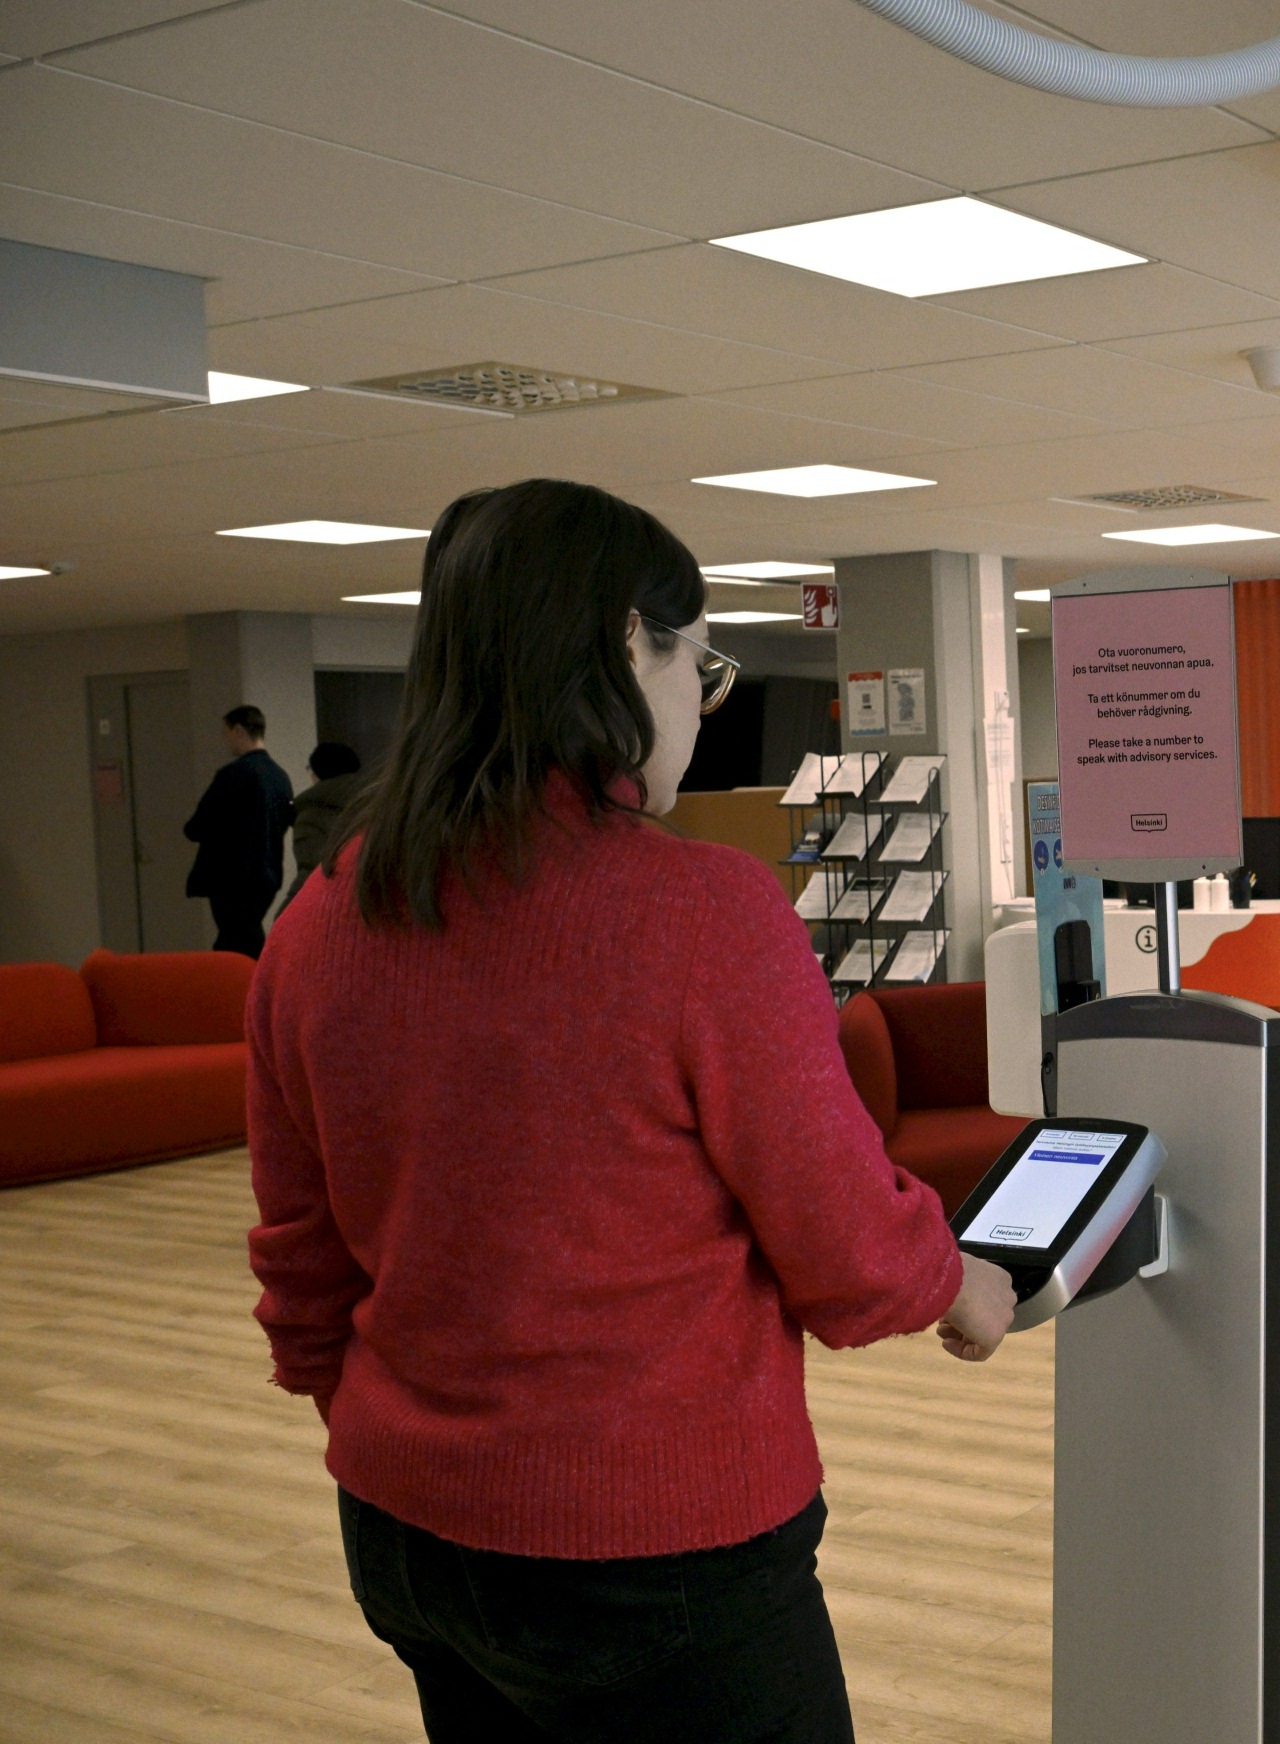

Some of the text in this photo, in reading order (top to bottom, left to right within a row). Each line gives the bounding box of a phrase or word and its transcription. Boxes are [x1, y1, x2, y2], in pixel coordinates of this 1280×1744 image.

[1098, 645, 1186, 658] Ota vuoronumero,
[1072, 659, 1214, 676] jos tarvitset neuvonnan apua.
[1088, 688, 1200, 703] Ta ett könummer om du
[1097, 704, 1193, 718] behöver rådgivning.
[1088, 739, 1120, 748] Please
[1122, 737, 1144, 747] take
[1153, 735, 1192, 746] number
[1193, 735, 1204, 744] to
[1077, 749, 1218, 767] speak with advisory services.
[996, 1229, 1026, 1237] Helsinki
